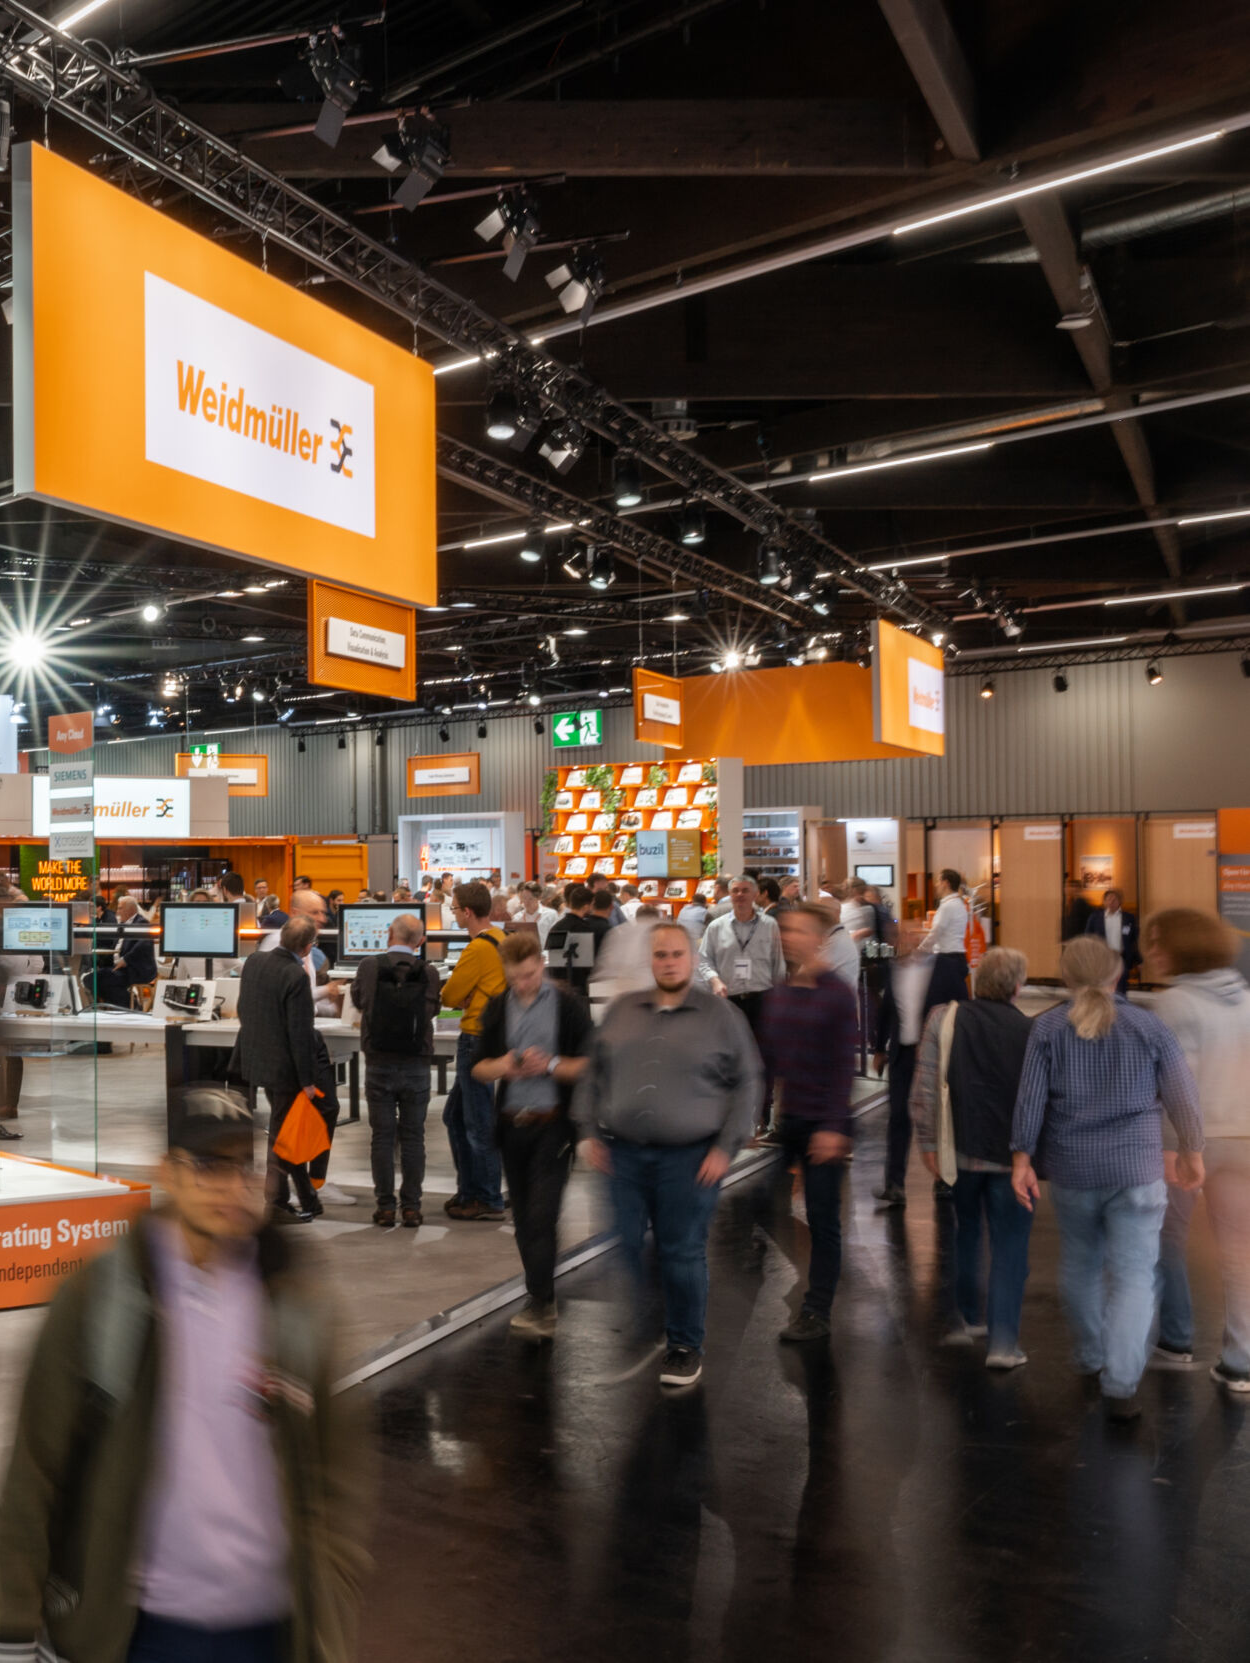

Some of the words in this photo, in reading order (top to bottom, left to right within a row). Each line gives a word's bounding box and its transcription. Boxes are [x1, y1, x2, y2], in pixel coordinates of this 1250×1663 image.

[176, 359, 324, 465] Weidmüller
[53, 769, 87, 782] SIEMENS
[94, 802, 150, 818] müller
[638, 843, 664, 856] buzil
[38, 860, 64, 874] MAKE
[66, 860, 82, 874] THE
[31, 876, 62, 891] WORLD
[63, 876, 88, 890] MORE
[57, 1218, 130, 1247] System
